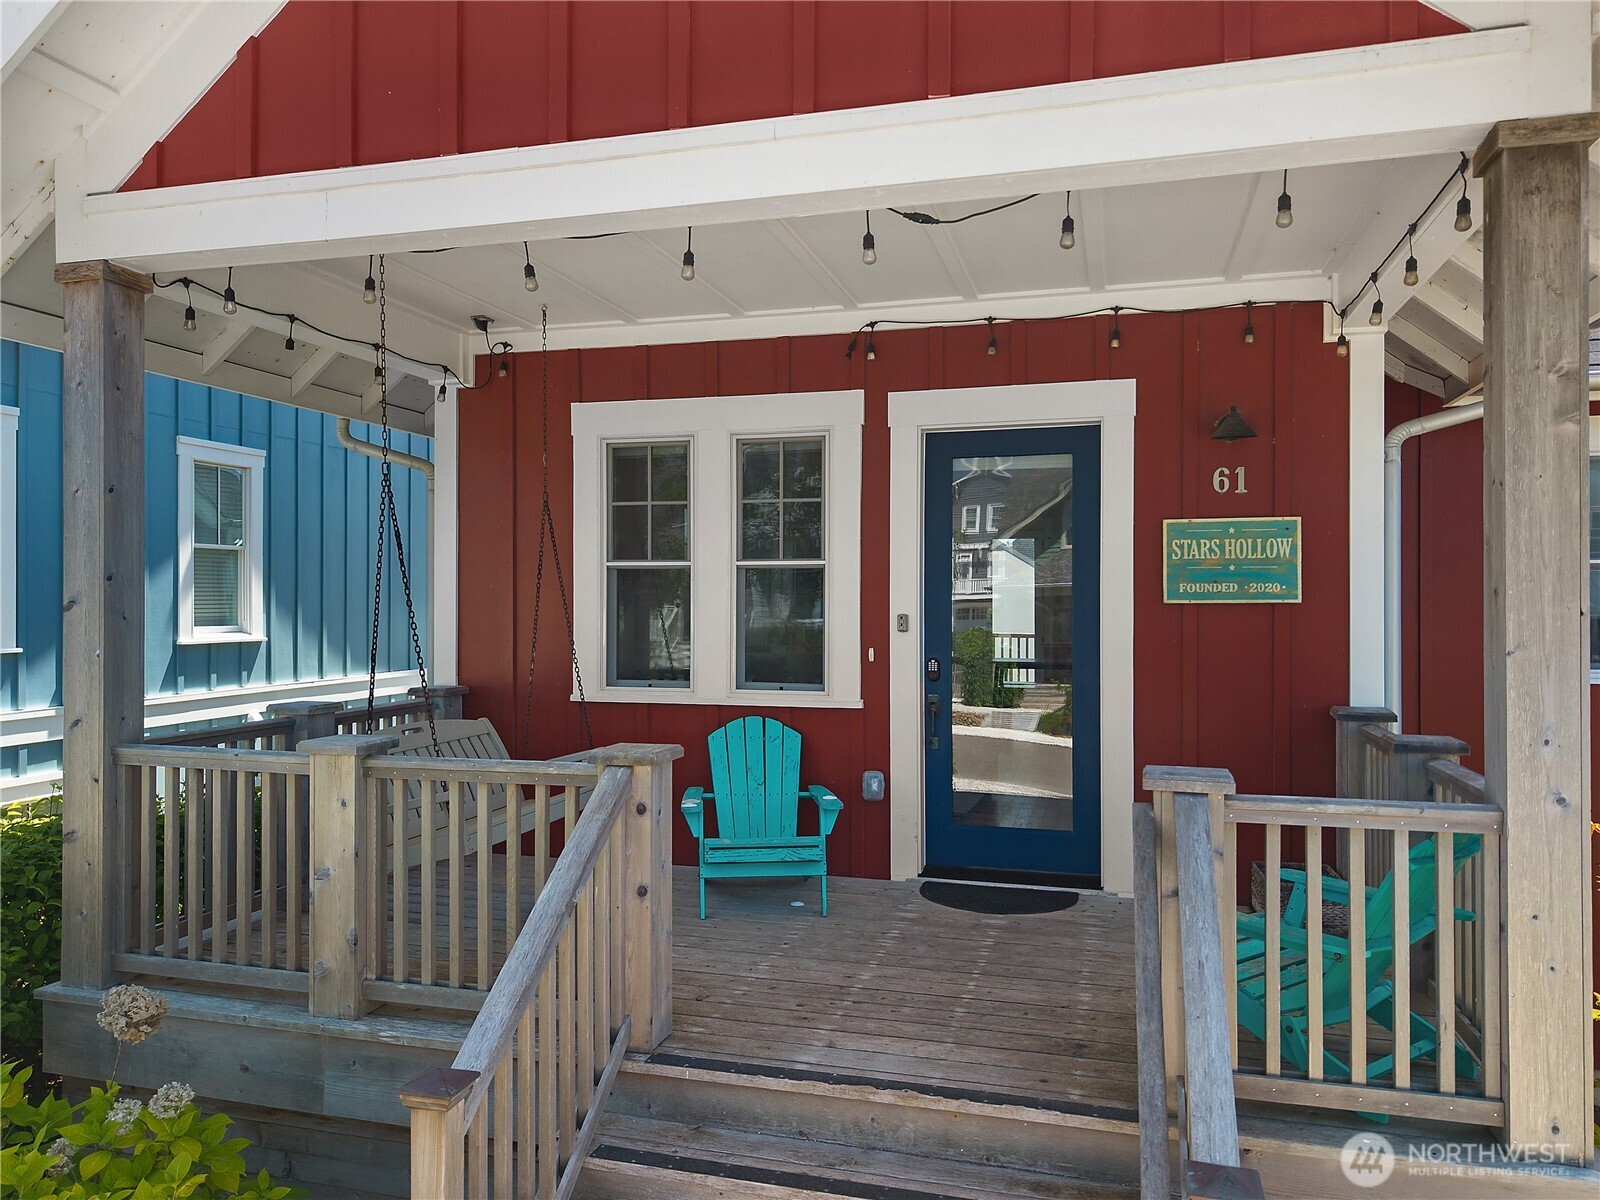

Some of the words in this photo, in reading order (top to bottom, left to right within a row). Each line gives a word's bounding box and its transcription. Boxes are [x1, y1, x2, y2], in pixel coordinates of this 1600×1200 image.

[1212, 466, 1248, 493] 61
[1171, 538, 1221, 560] STARS
[1224, 537, 1293, 559] HOLLOW
[1179, 583, 1238, 593] FOUNDED
